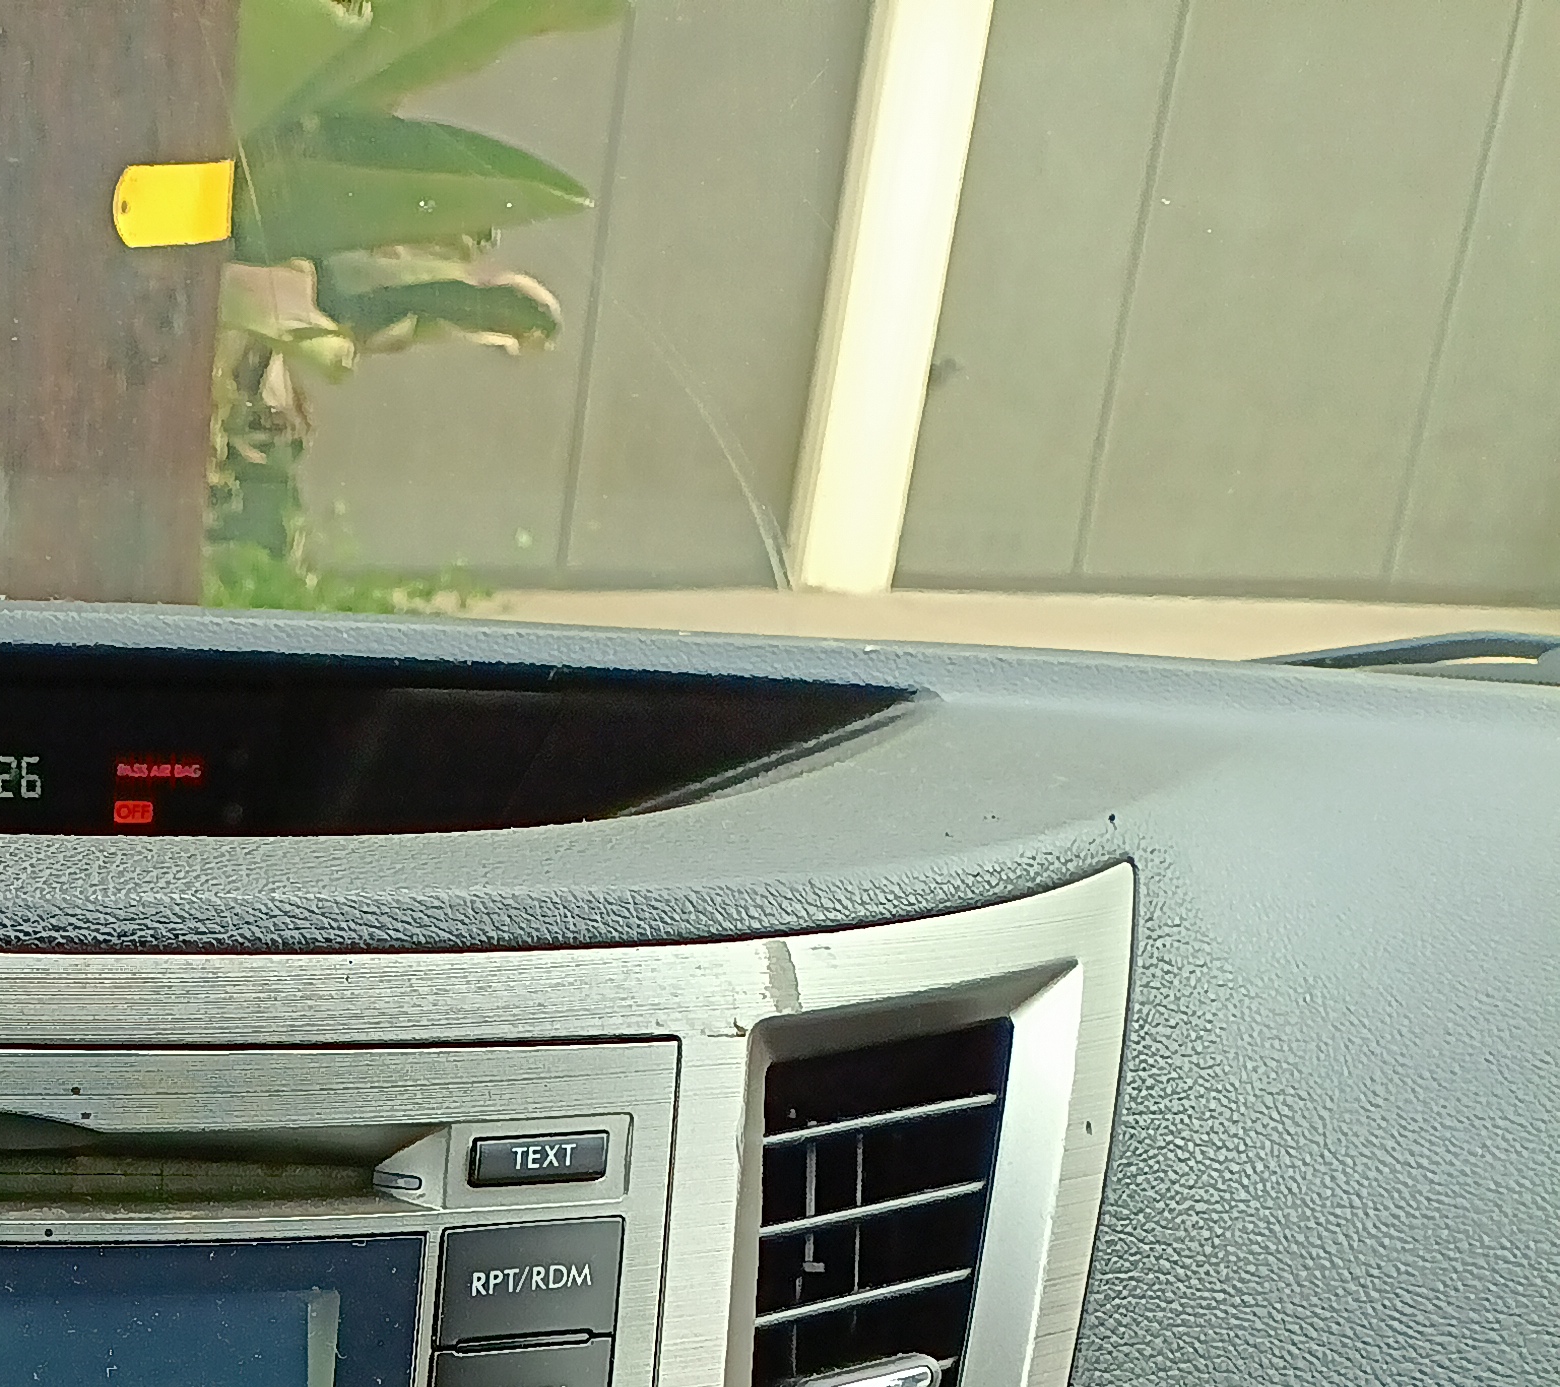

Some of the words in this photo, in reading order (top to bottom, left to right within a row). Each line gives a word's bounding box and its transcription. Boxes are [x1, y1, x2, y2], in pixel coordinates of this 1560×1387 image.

[174, 764, 202, 778] BAG
[116, 804, 151, 820] OFF
[510, 1143, 577, 1170] TEXT
[471, 1263, 592, 1297] RPT/RDM
